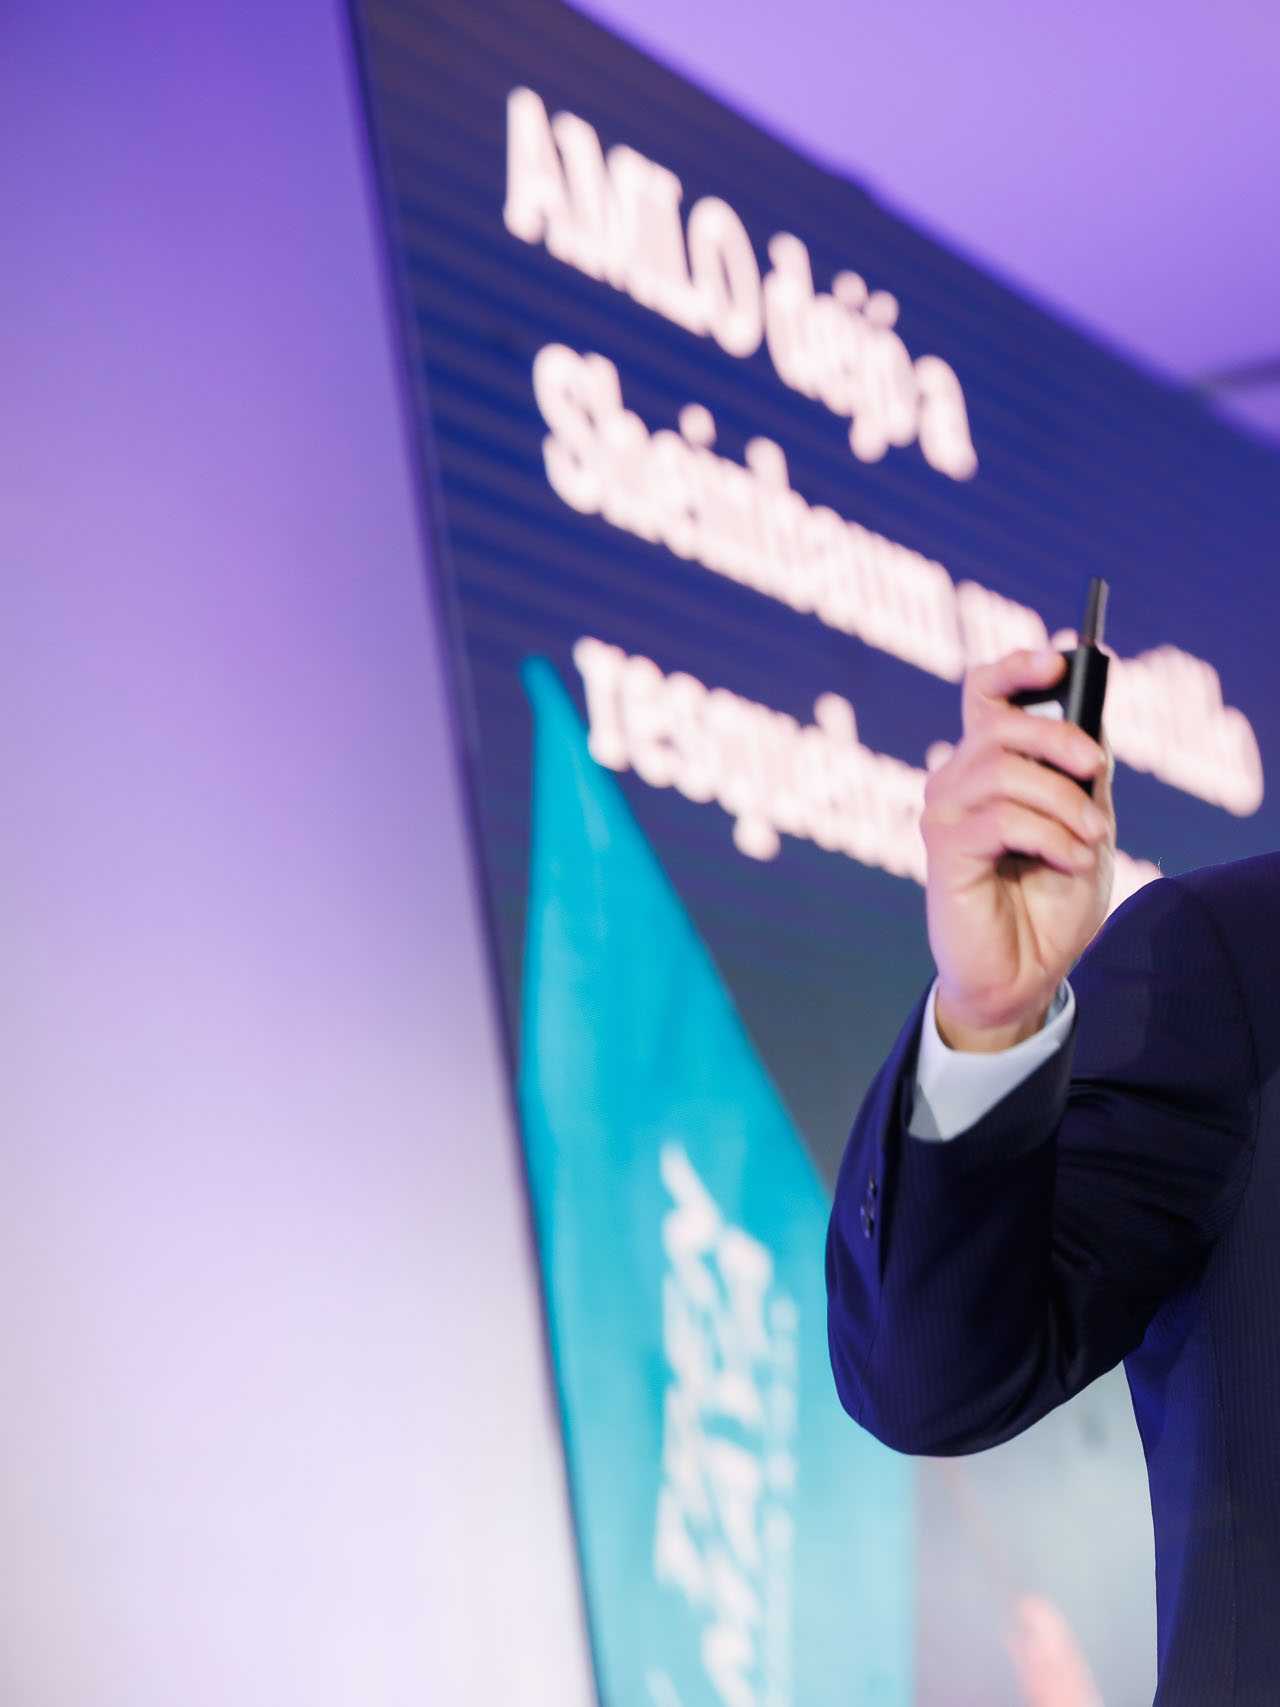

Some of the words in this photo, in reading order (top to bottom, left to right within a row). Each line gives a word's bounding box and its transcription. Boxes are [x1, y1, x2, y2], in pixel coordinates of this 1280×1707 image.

[504, 86, 763, 358] AMLO
[915, 354, 978, 480] a
[532, 342, 960, 683] Sheinbaum
